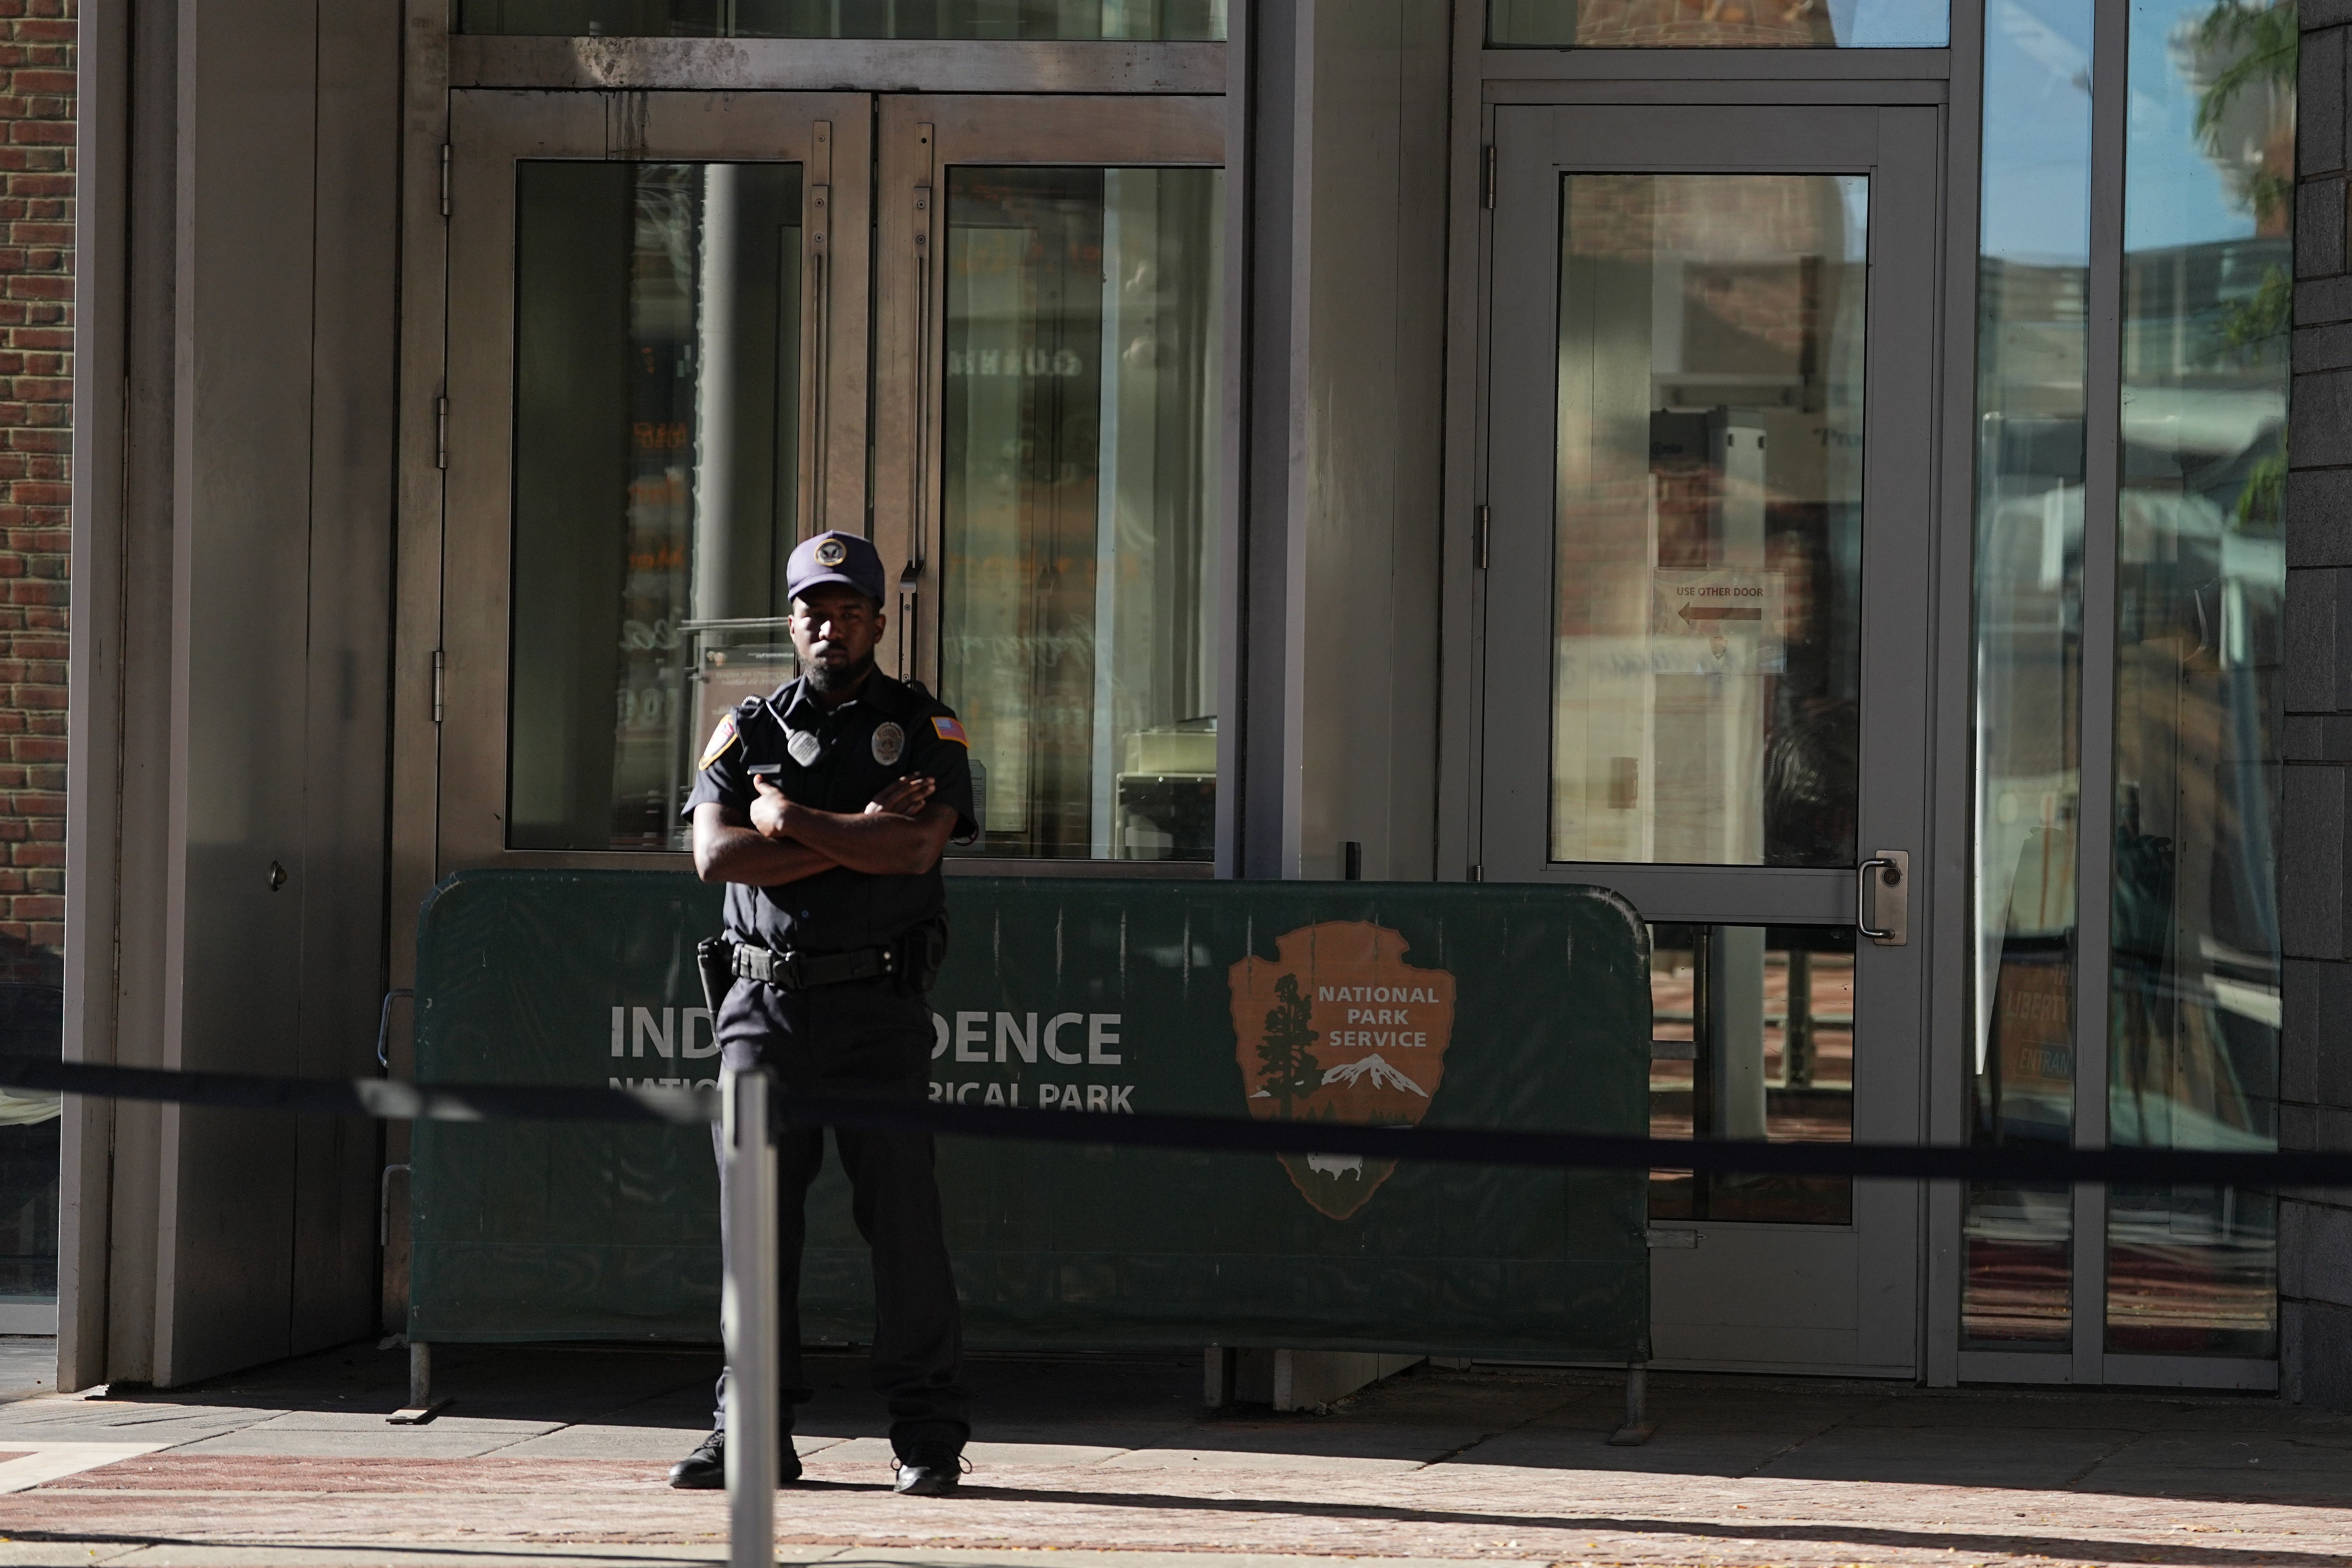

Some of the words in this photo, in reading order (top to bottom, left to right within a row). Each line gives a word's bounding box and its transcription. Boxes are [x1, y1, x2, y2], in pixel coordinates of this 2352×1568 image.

[1677, 587, 1695, 596] USE
[1698, 588, 1731, 596] OTHER
[1734, 588, 1763, 596] DOOR
[2054, 963, 2071, 986] TH
[1319, 986, 1439, 1003] NATIONAL
[1348, 1008, 1409, 1025] PARK
[2005, 990, 2071, 1023] LIBERTY
[1329, 1030, 1426, 1047] SERVICE
[2020, 1048, 2071, 1074] ENTRAN
[1039, 1083, 1135, 1115] PARK
